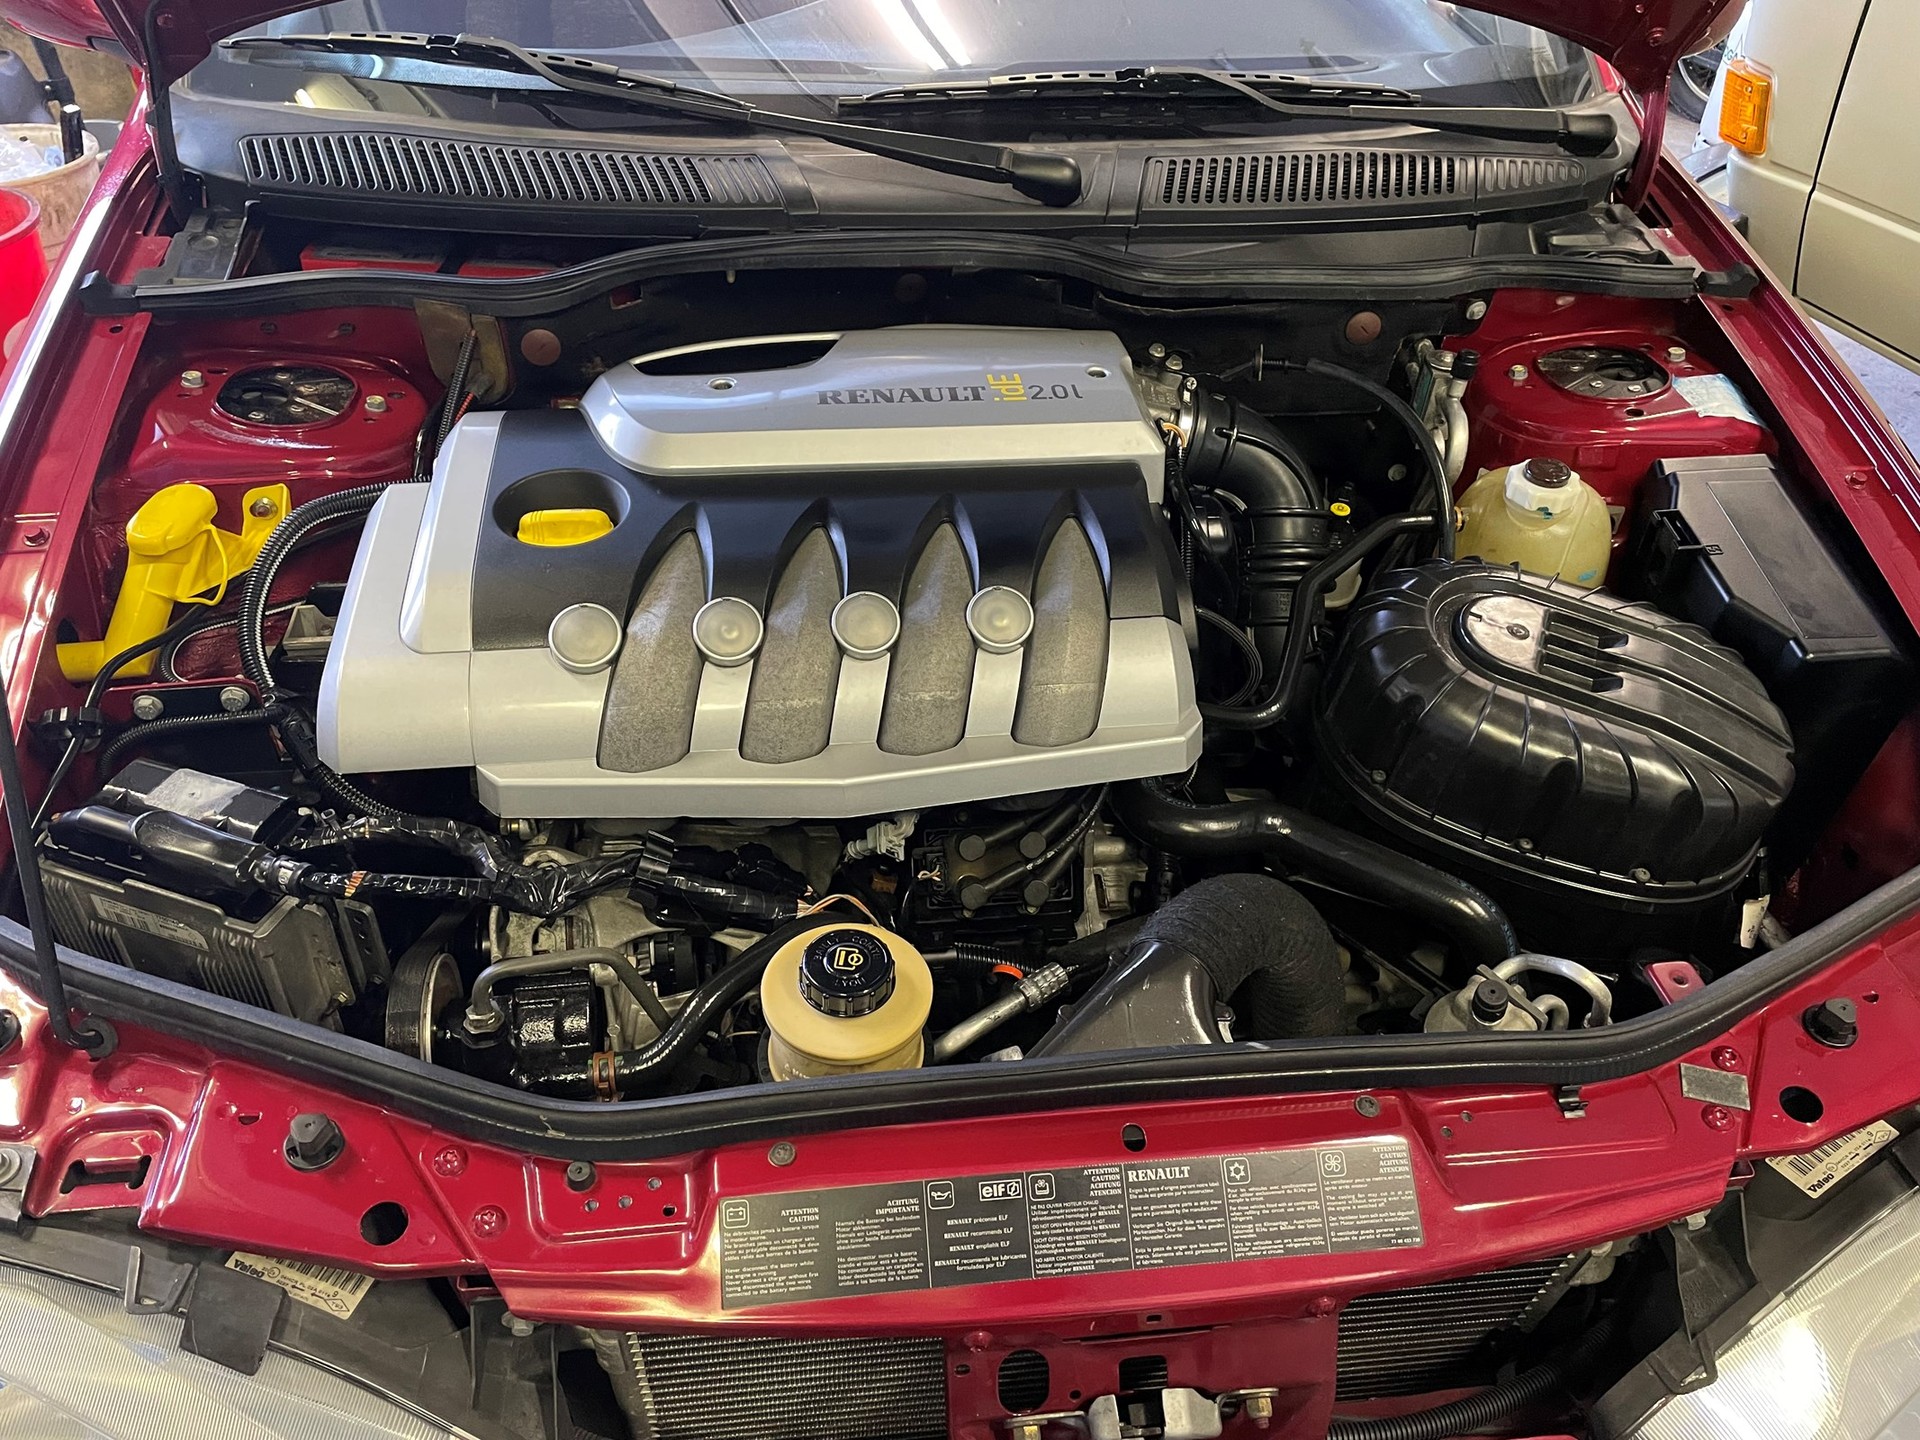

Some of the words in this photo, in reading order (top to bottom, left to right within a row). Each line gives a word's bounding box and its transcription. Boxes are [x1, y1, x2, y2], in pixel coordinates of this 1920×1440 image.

[817, 386, 986, 405] RENAULT
[852, 936, 880, 959] COMTE
[1372, 1144, 1405, 1152] ATTENTION
[1380, 1151, 1406, 1159] CAUTION
[1379, 1158, 1408, 1166] ACHTUNG
[1083, 1166, 1119, 1175] ATTENTION
[1127, 1165, 1190, 1182] RENAULT
[1090, 1181, 1120, 1189] ACHTUNG
[1808, 1173, 1834, 1193] Valeo
[982, 1183, 1004, 1197] elf
[887, 1197, 919, 1206] ACHTUNG
[781, 1207, 818, 1216] ATTENTION
[875, 1205, 919, 1214] IMPORTANTE
[789, 1214, 818, 1222] CAUTION
[946, 1217, 971, 1225] RENAULT
[934, 1258, 959, 1266] RENAULT
[234, 1259, 265, 1278] Valeo
